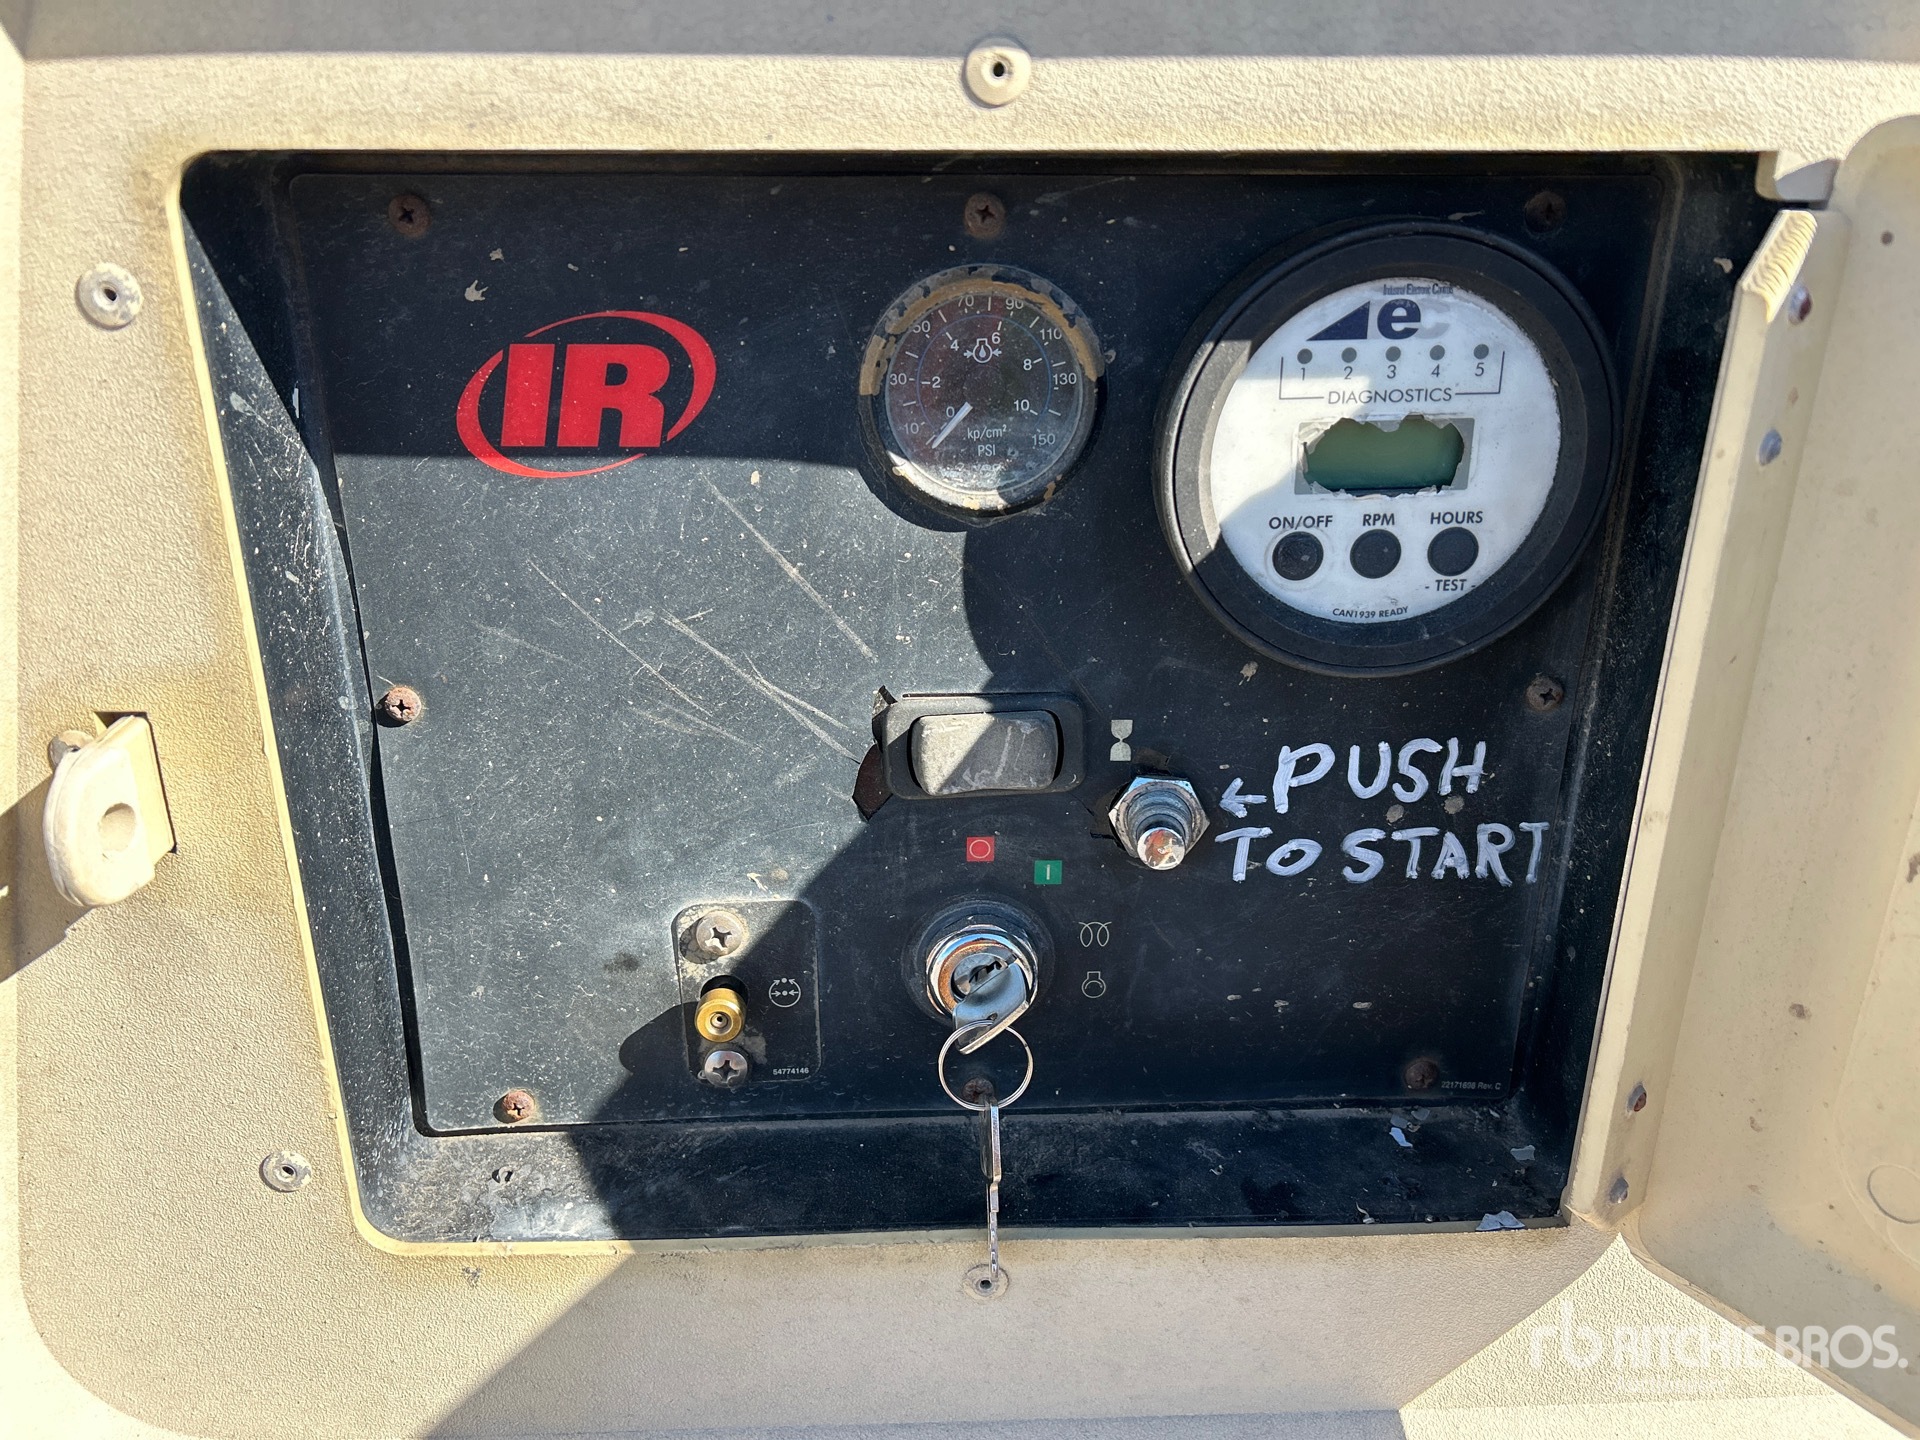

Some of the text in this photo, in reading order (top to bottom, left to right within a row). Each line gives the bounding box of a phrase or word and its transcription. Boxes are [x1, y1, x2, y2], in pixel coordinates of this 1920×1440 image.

[958, 295, 974, 308] 70
[1005, 298, 1024, 310] 90
[912, 320, 931, 333] 50
[992, 332, 1000, 345] 6
[1039, 328, 1062, 340] 110
[950, 340, 960, 351] 4
[1023, 359, 1032, 371] 8
[1344, 366, 1353, 380] 2
[1386, 365, 1397, 379] 3
[1431, 364, 1441, 378] 4
[1474, 363, 1485, 376] 5
[890, 373, 907, 386] 30
[932, 377, 941, 388] 2
[1053, 373, 1077, 385] 130
[501, 344, 670, 447] IR
[1328, 388, 1452, 404] DIAGNOSTICS
[946, 406, 955, 418] 0
[1014, 400, 1030, 412] 10
[903, 423, 919, 434] 10
[1032, 434, 1056, 446] 150
[978, 445, 996, 456] PSI
[1268, 511, 1484, 530] ON/OFF RPM HOURS
[1332, 606, 1409, 619] CAN1939 READY
[1272, 737, 1487, 814] PUSH
[1215, 821, 1550, 887] TO START
[773, 1067, 809, 1075] 54774146
[1478, 1082, 1493, 1090] Rev.
[1495, 1082, 1501, 1090] C
